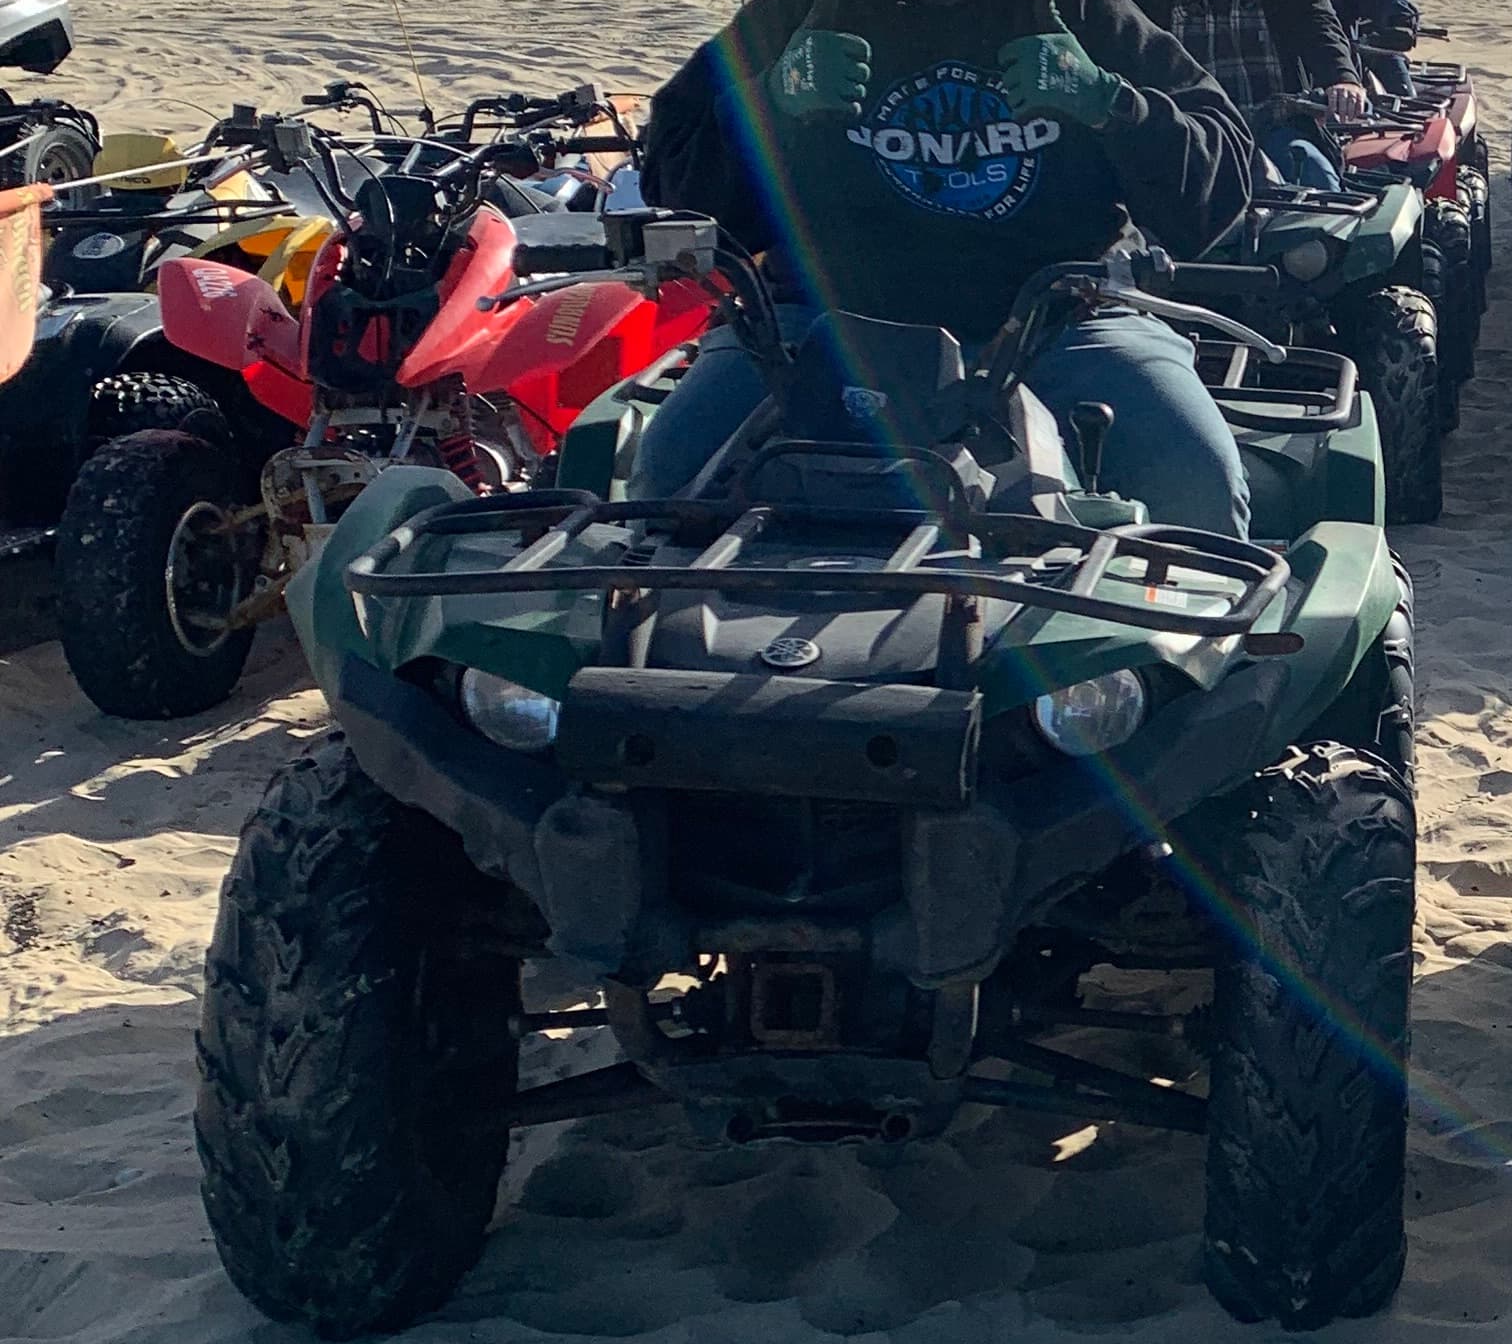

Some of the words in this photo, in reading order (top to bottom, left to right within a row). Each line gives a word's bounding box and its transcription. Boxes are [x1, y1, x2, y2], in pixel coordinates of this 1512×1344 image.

[936, 67, 977, 83] FOR
[904, 164, 1008, 188] TOLS
[984, 194, 1017, 220] FOR
[1016, 157, 1035, 193] LIFE
